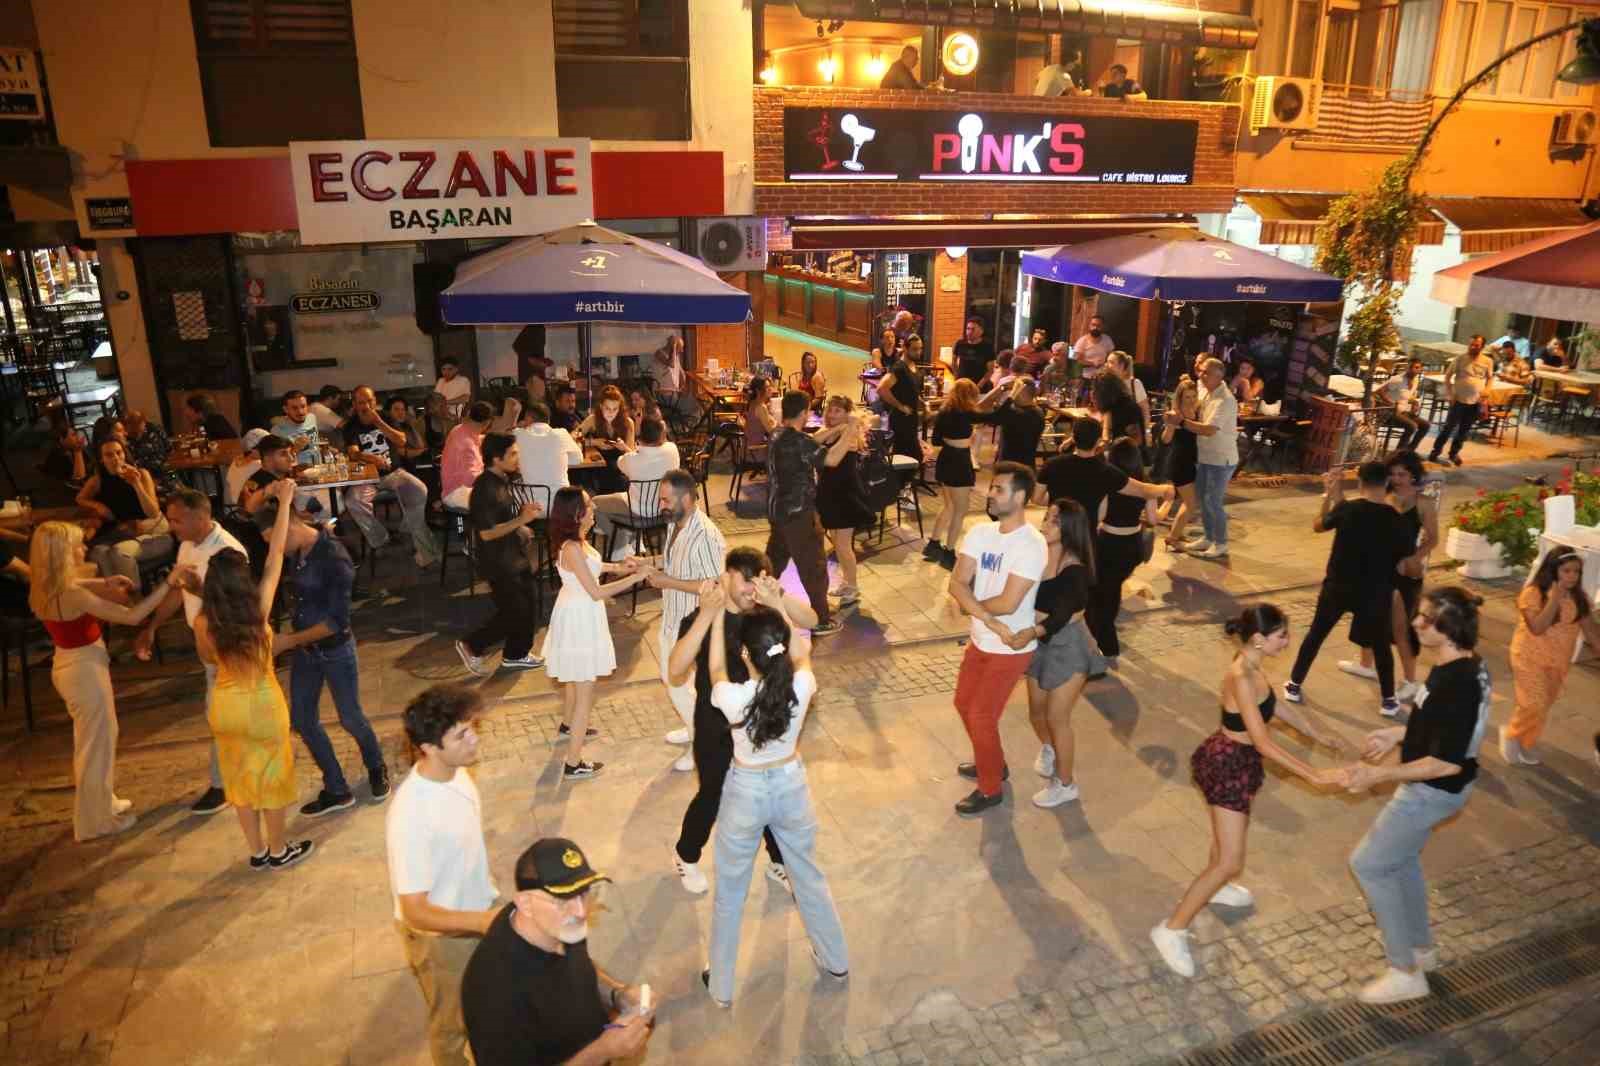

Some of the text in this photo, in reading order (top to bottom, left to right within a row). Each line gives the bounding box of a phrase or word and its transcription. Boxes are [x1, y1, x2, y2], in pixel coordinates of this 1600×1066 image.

[308, 149, 579, 203] ECZANE
[1102, 173, 1124, 182] CAFE
[1156, 173, 1188, 184] LOUNGE
[389, 206, 513, 234] BAŞARAN
